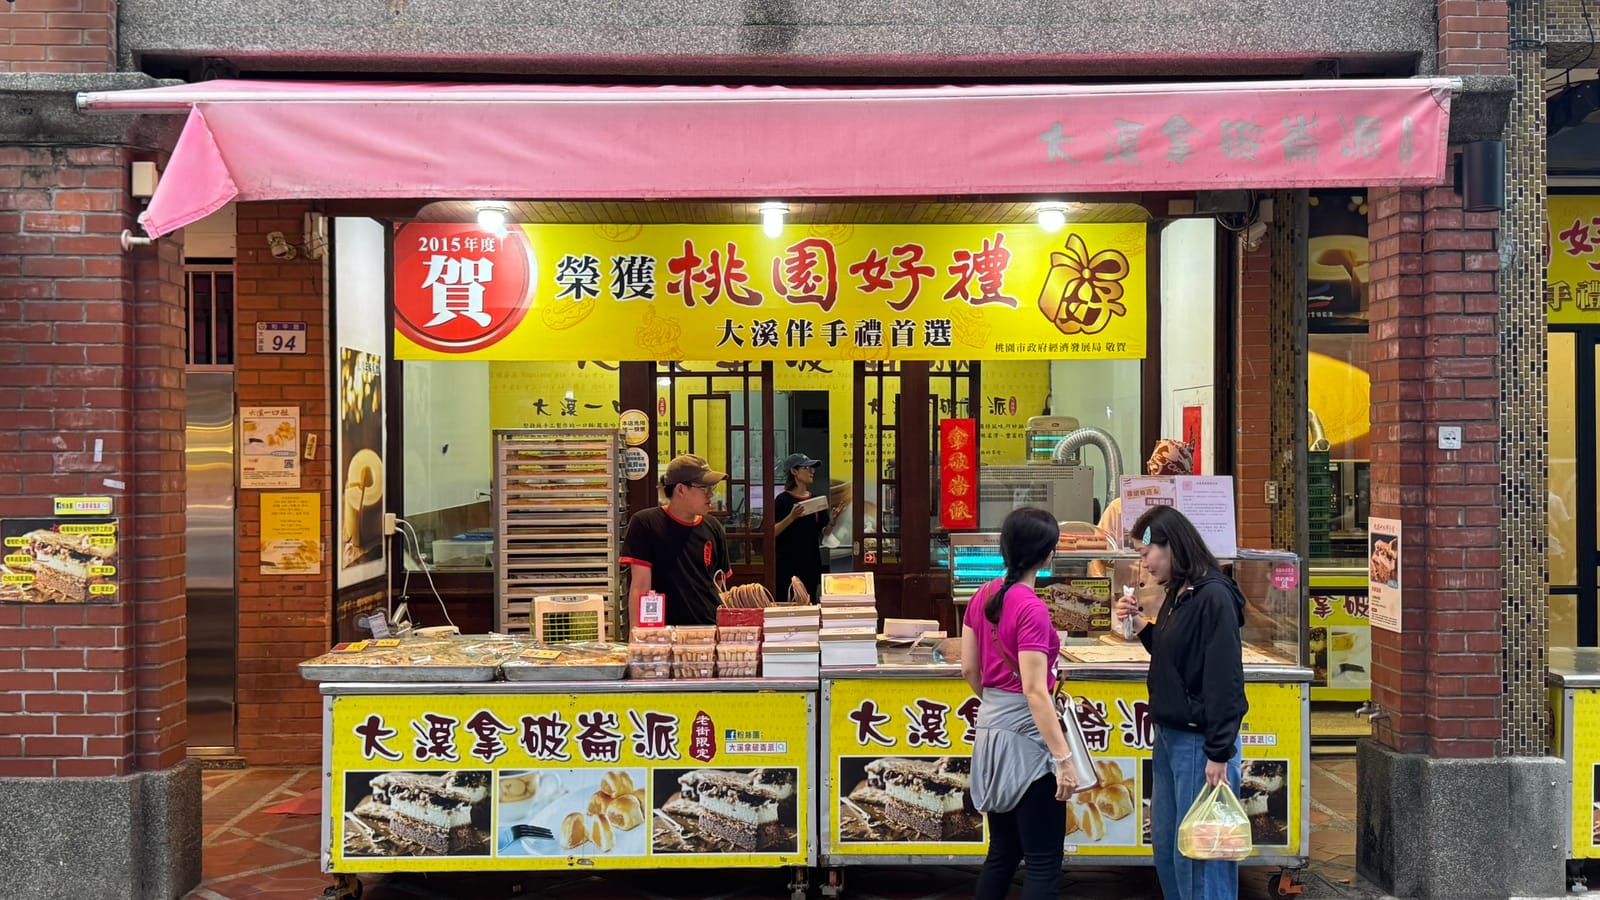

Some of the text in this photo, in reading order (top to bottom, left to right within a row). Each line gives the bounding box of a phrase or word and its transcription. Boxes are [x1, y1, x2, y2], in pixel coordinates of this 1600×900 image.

[418, 237, 496, 252] 2015年度
[421, 255, 494, 328] 賀
[272, 335, 297, 351] 94
[716, 319, 953, 348] 大溪伴手禮首選
[994, 341, 1127, 354] 桃園市政府經濟發展局 敬賀
[532, 398, 620, 417] 大溪一
[947, 425, 973, 521] 拿破崙派
[354, 709, 680, 763] 大溪拿破崙派
[695, 714, 711, 760] 老街限定
